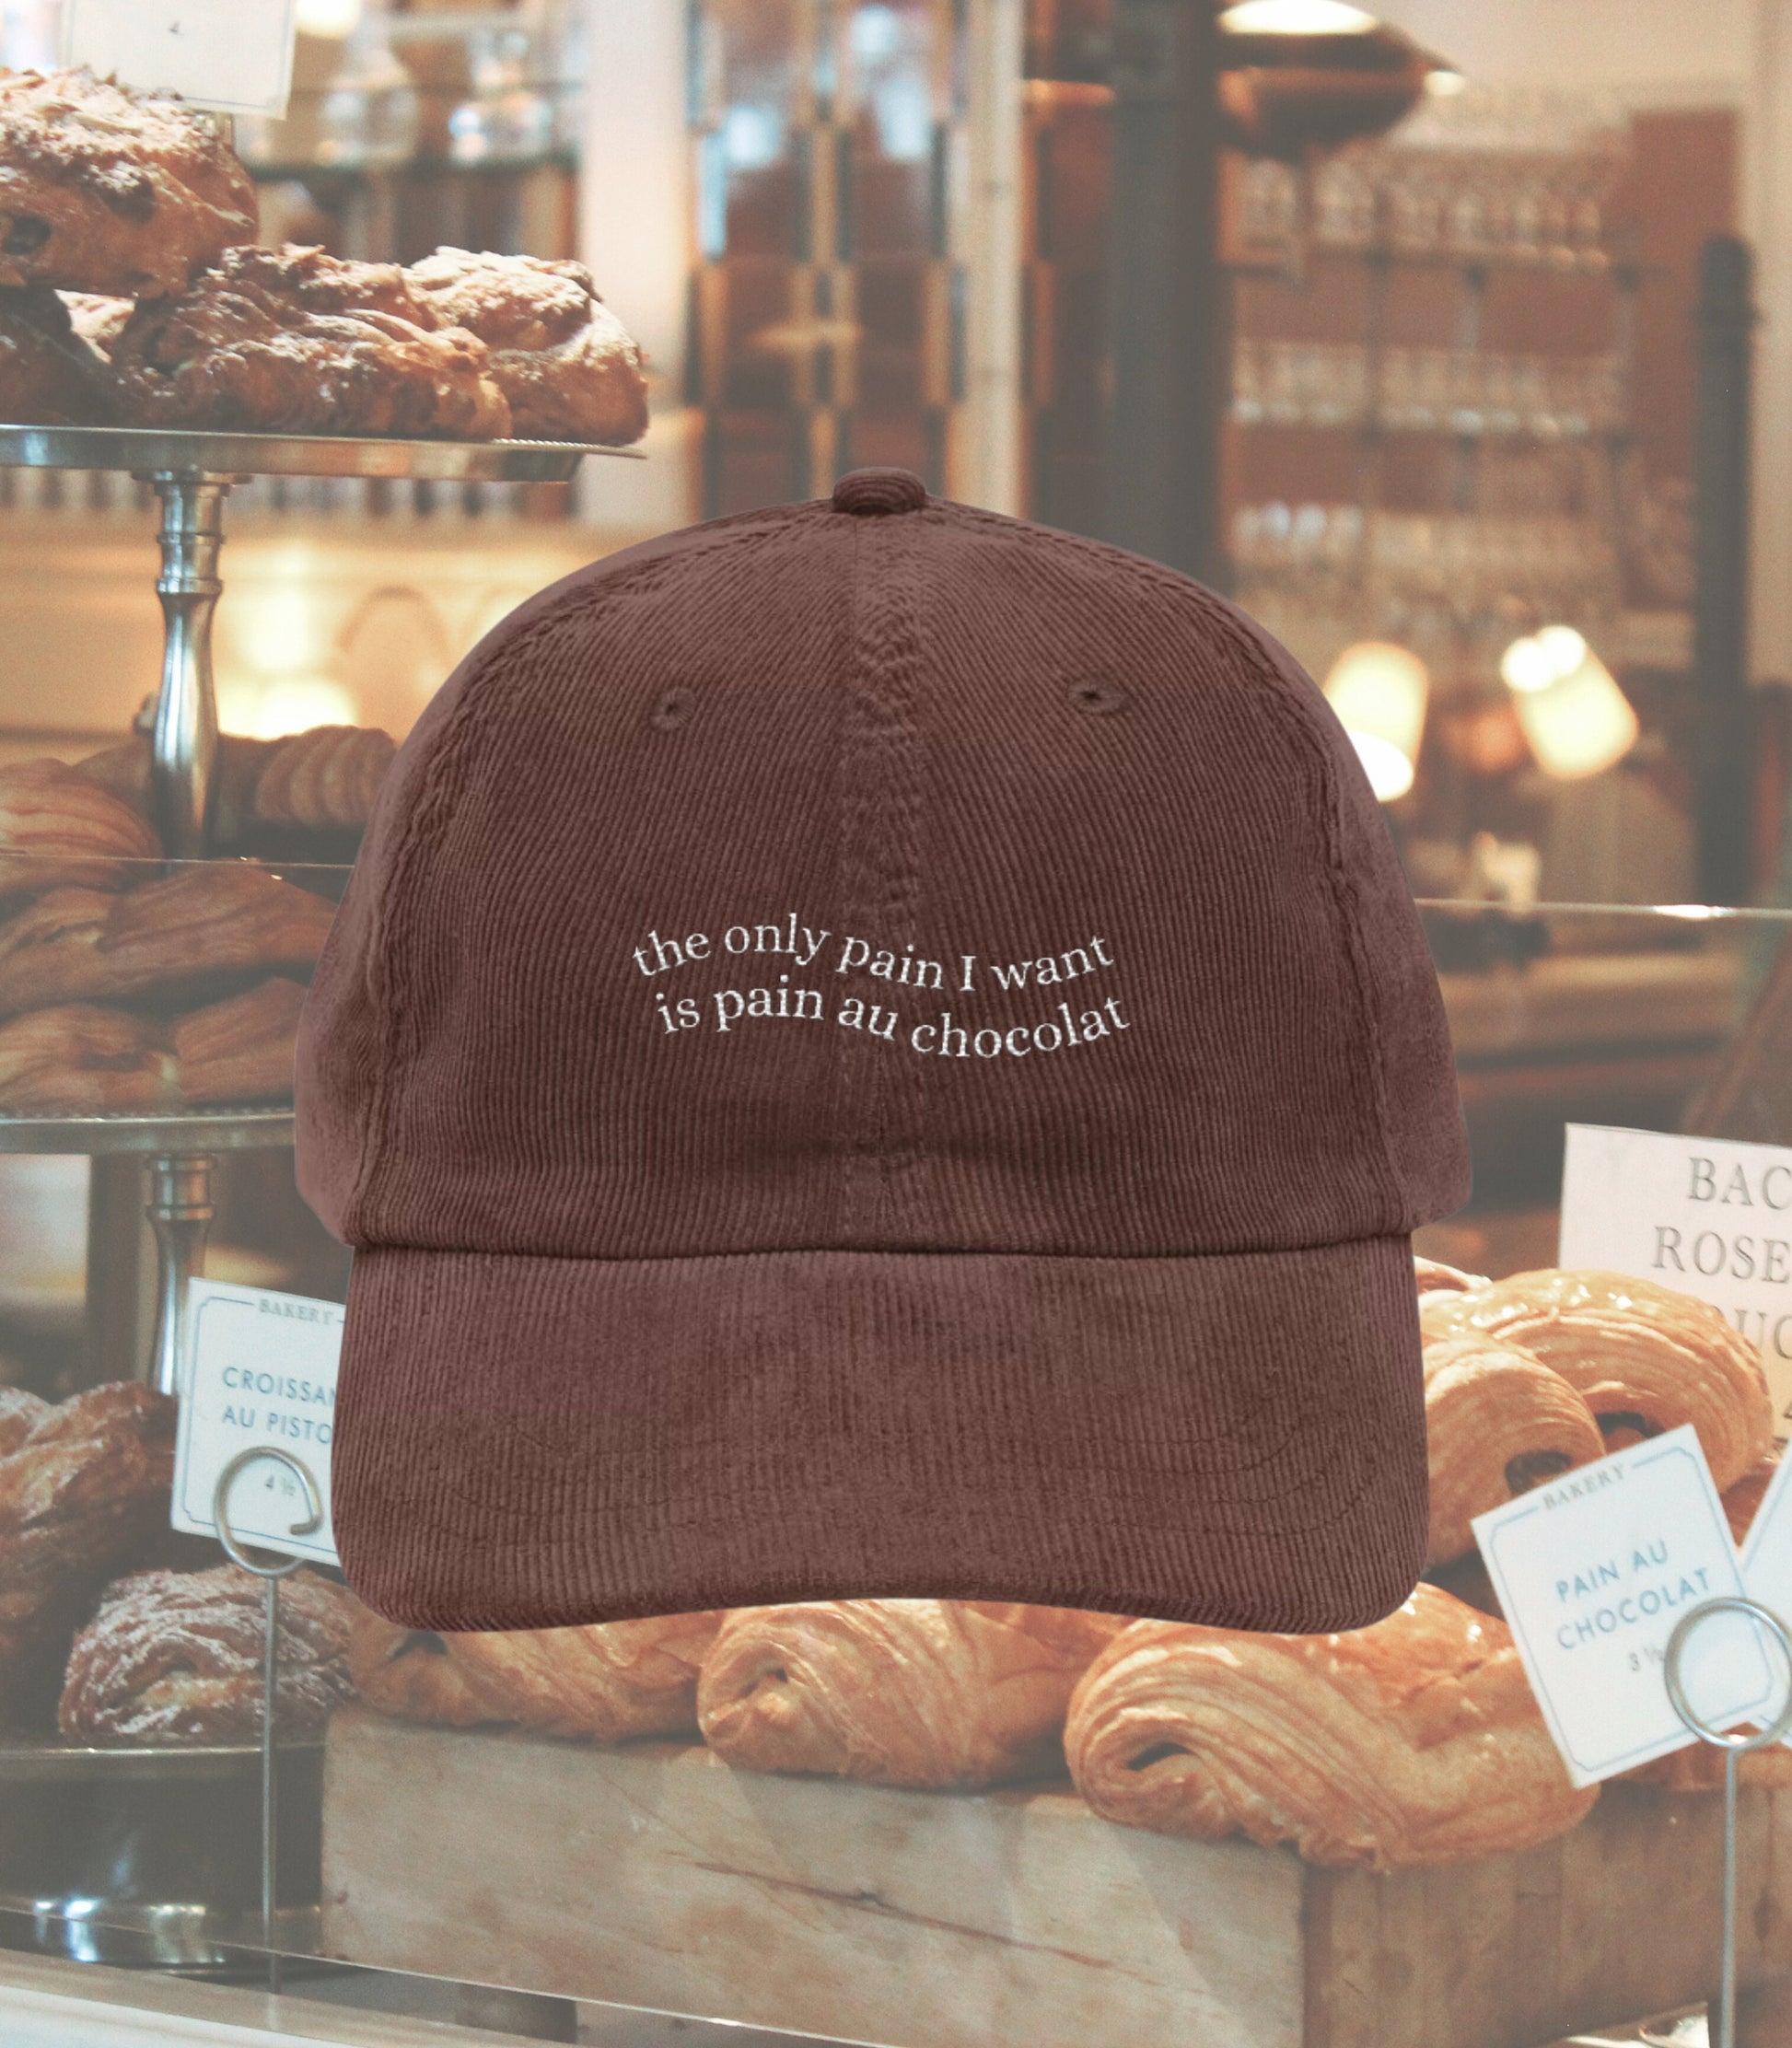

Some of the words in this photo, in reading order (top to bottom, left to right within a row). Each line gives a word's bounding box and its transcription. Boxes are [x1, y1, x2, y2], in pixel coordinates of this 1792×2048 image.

[633, 930, 711, 976] the
[725, 913, 832, 965] only
[836, 937, 943, 990] pain
[960, 955, 977, 992] I
[990, 936, 1114, 991] want
[656, 993, 701, 1034] is
[714, 974, 824, 1032] pain
[838, 998, 899, 1041] au
[911, 997, 1130, 1059] chocolat
[1688, 1157, 1792, 1211] BAC
[1652, 1226, 1790, 1285] ROSE
[259, 1298, 333, 1325] BAKERY
[222, 1404, 255, 1428] AU
[266, 1412, 332, 1444] PISTO
[1542, 1464, 1626, 1510] BAKERY
[1555, 1560, 1621, 1602] PAIN
[1634, 1540, 1669, 1577] AU
[1556, 1568, 1711, 1650] CHOCOLAT
